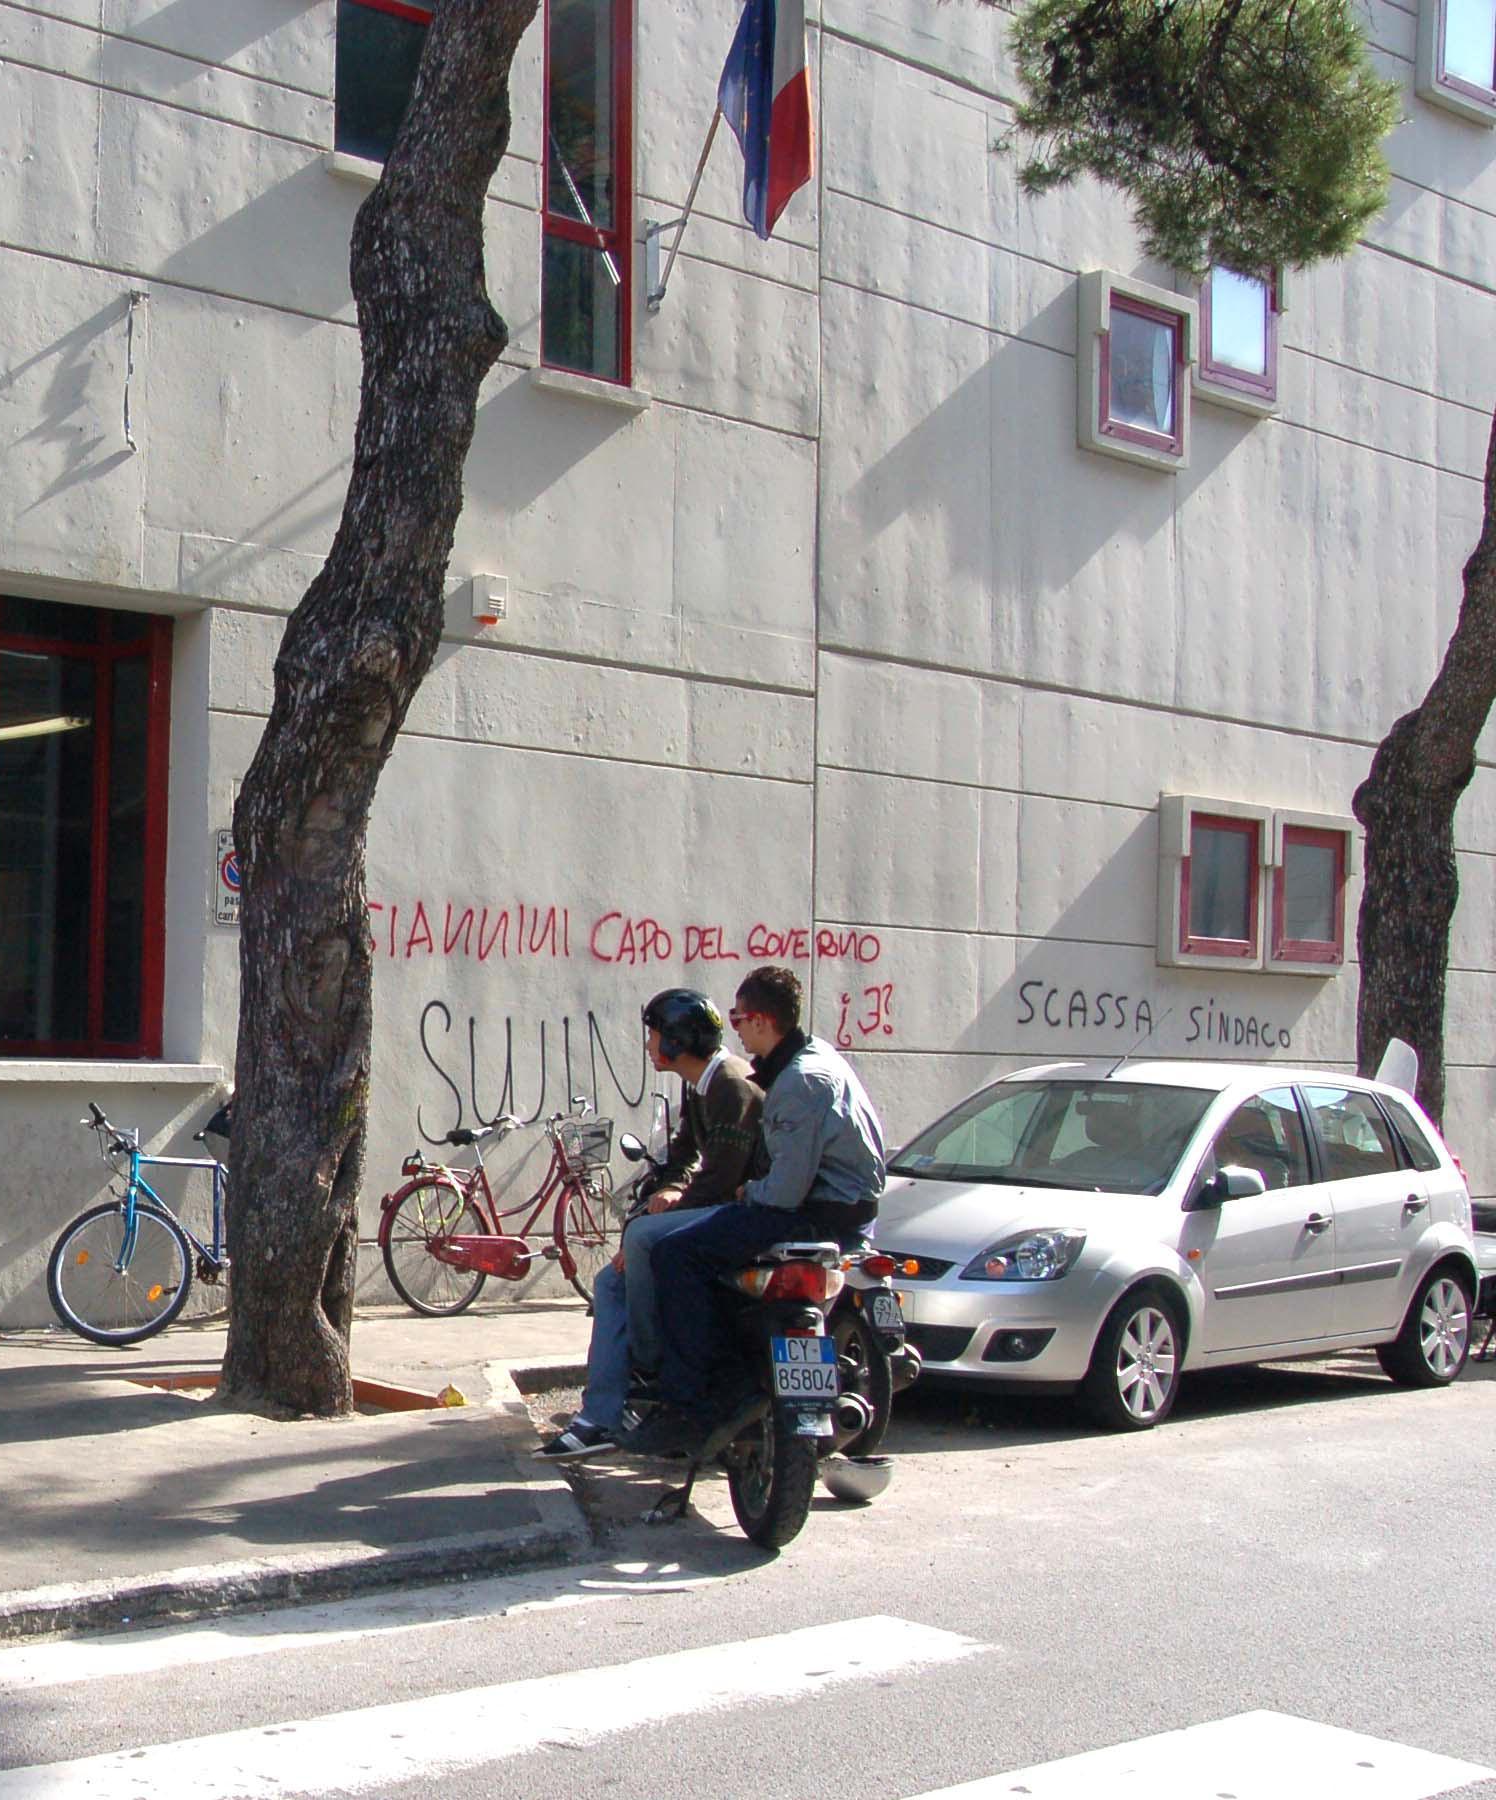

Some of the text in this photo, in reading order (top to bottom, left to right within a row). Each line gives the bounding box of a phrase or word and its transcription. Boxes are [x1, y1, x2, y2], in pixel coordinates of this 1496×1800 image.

[590, 911, 673, 965] CAPO
[684, 925, 741, 964] DEL
[747, 923, 881, 964] GOVERNO
[1017, 980, 1154, 1035] SCASSA
[787, 1339, 809, 1361] CY
[778, 1368, 835, 1391] 85804
